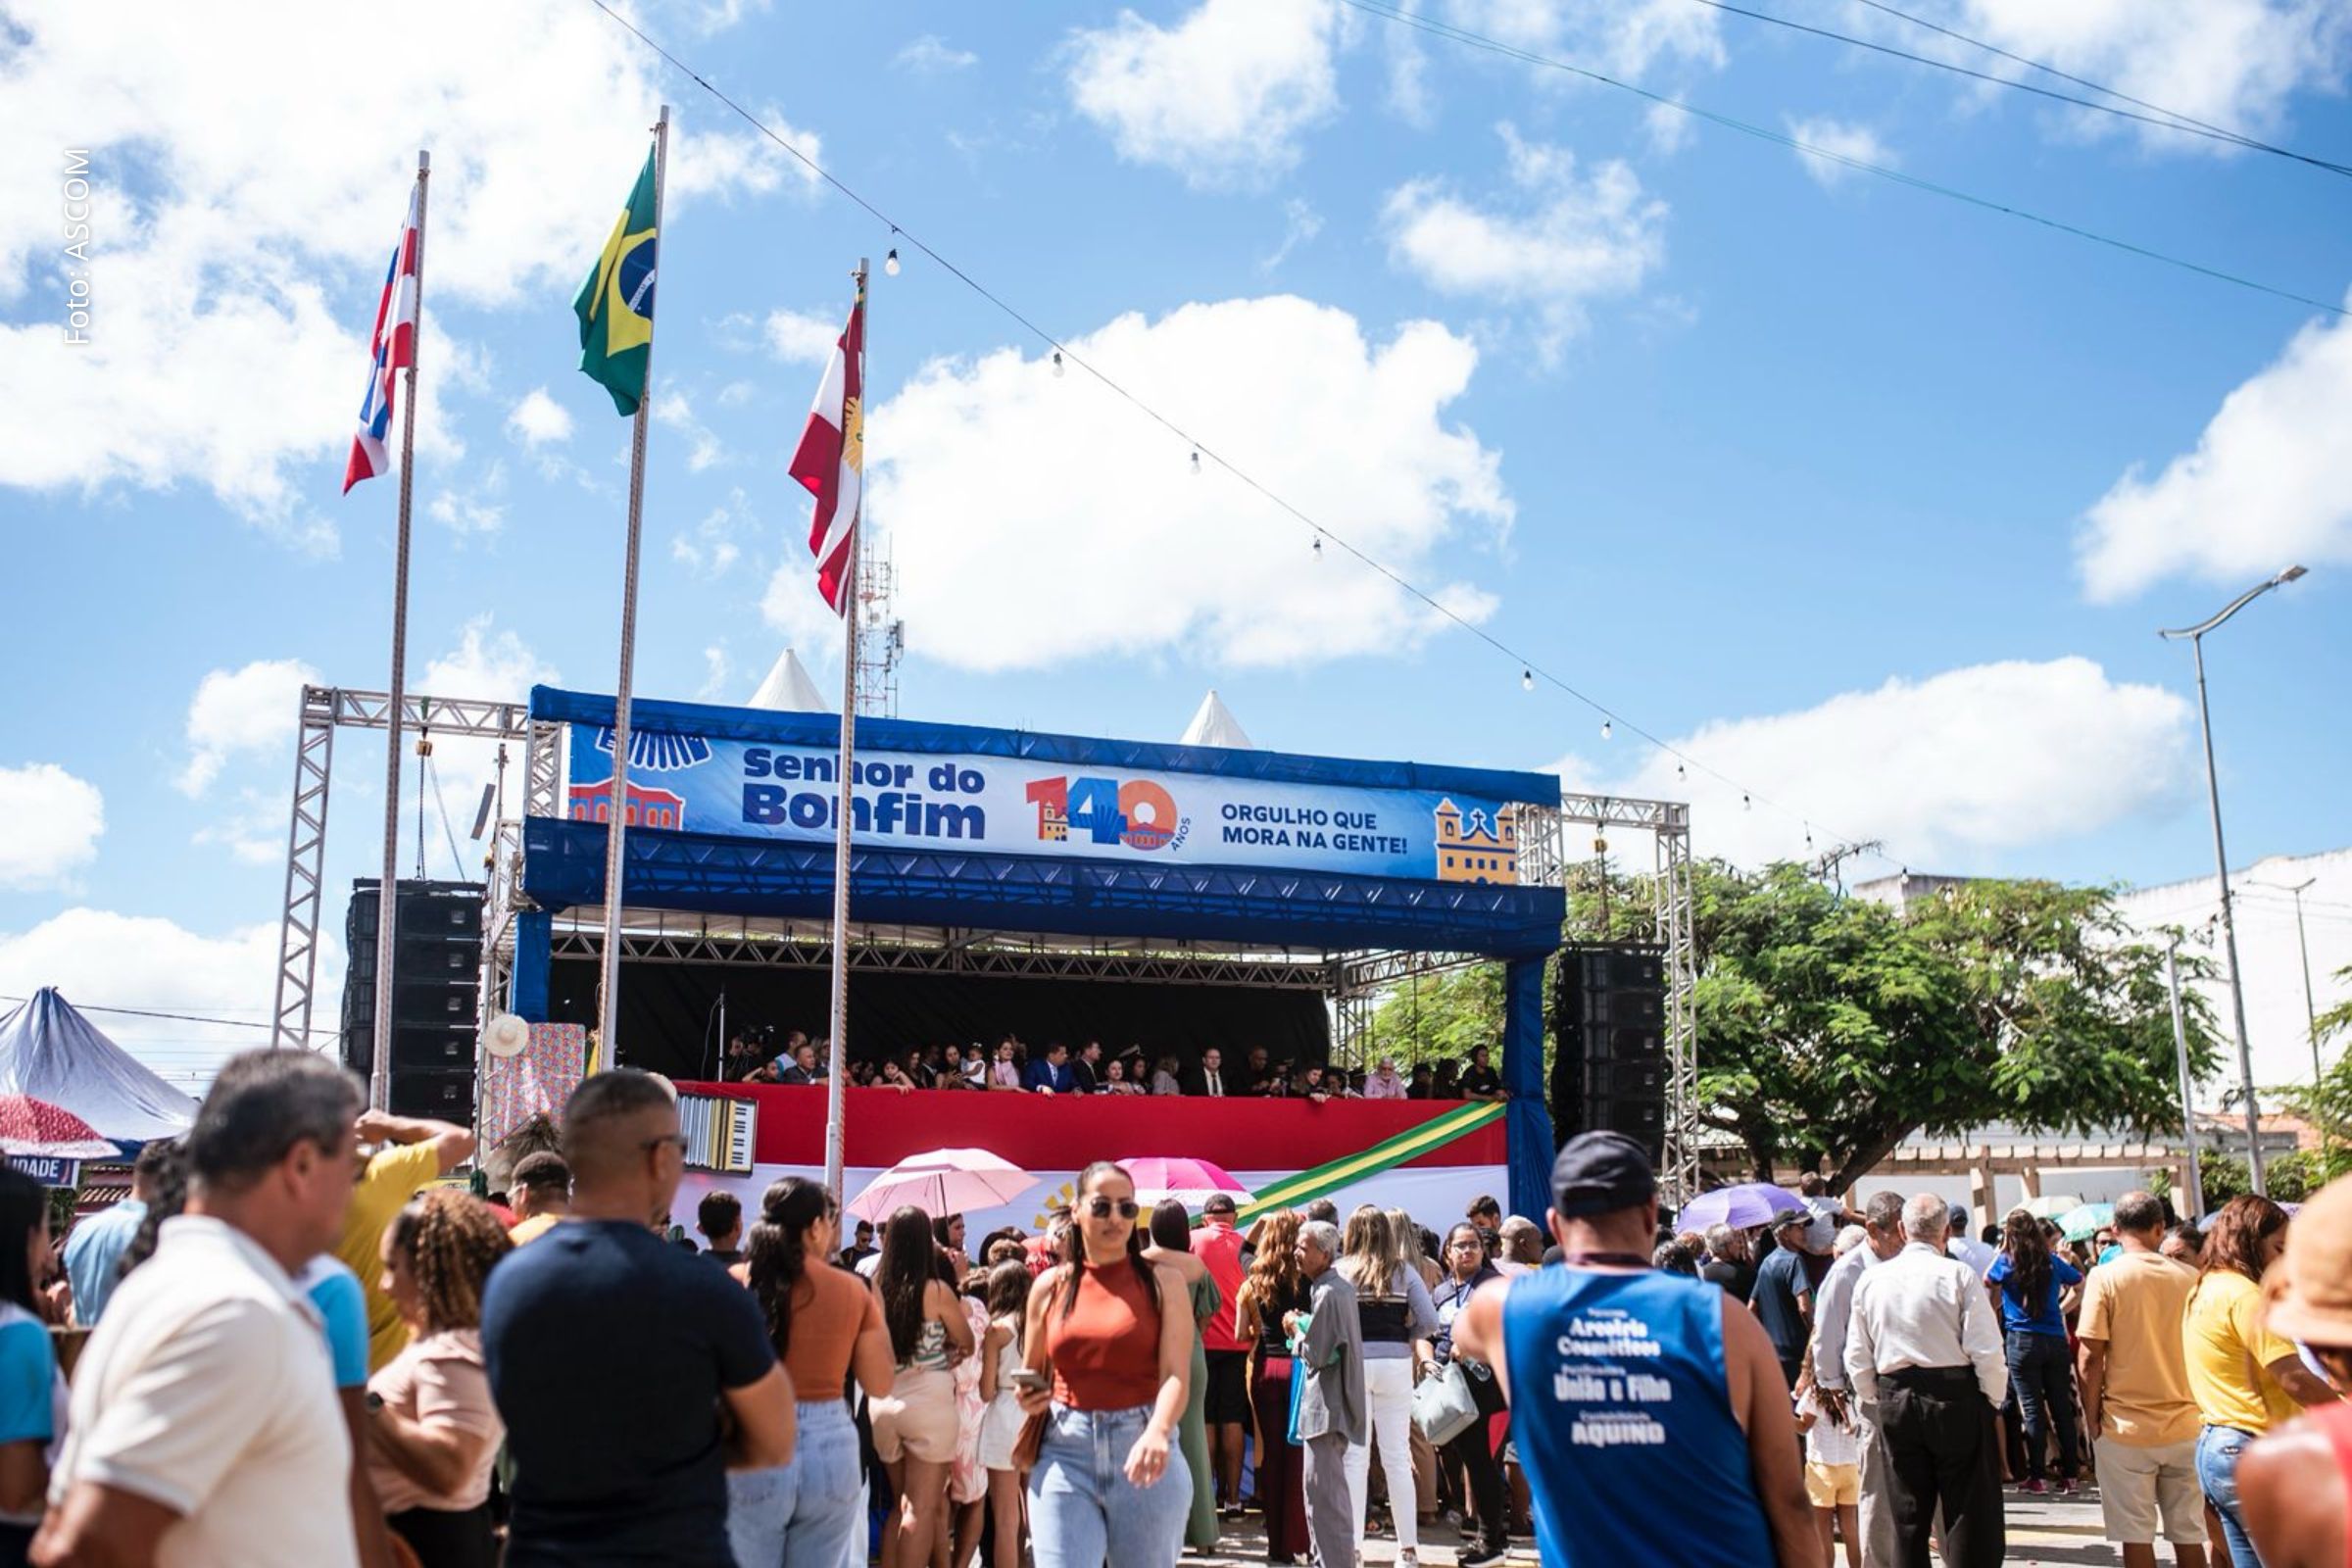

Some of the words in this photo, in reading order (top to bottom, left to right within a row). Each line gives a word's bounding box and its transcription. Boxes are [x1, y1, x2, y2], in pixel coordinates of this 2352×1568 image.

[743, 748, 914, 789] Senhor
[928, 763, 986, 795] do
[742, 782, 986, 840] Bonfim
[1026, 776, 1177, 852] 140
[1221, 804, 1329, 827] ORGULHO
[1333, 811, 1378, 831] QUE
[1169, 816, 1192, 853] ANOS
[1222, 826, 1291, 848] MORA
[1297, 831, 1328, 850] NA
[1333, 834, 1408, 856] GENTE!
[1571, 1422, 1666, 1448] AQUINO
